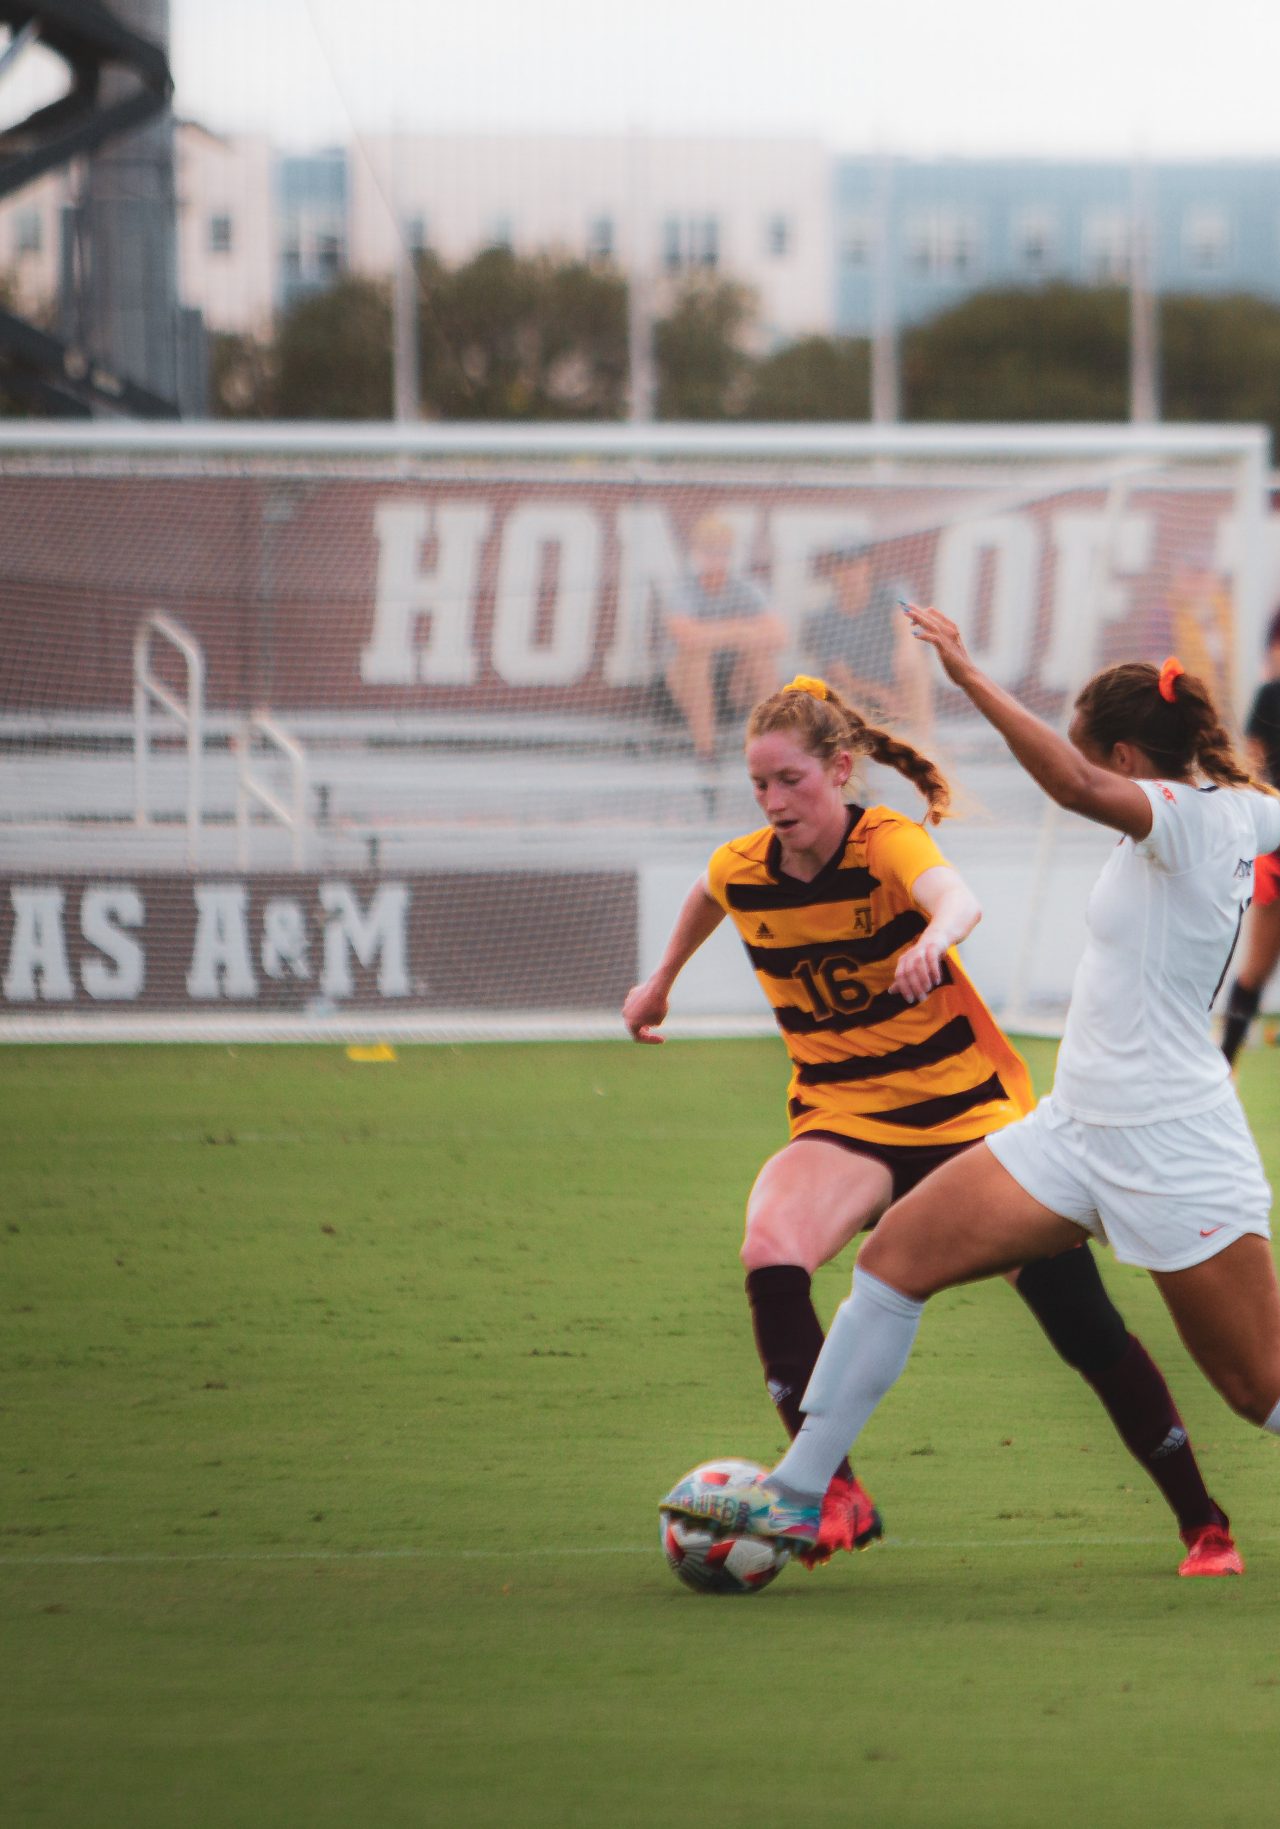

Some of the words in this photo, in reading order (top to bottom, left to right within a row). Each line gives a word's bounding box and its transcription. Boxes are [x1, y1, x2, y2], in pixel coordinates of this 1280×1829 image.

[360, 502, 872, 688] HOME
[932, 508, 1156, 692] OF
[186, 881, 412, 997] A&M
[792, 955, 874, 1022] 16
